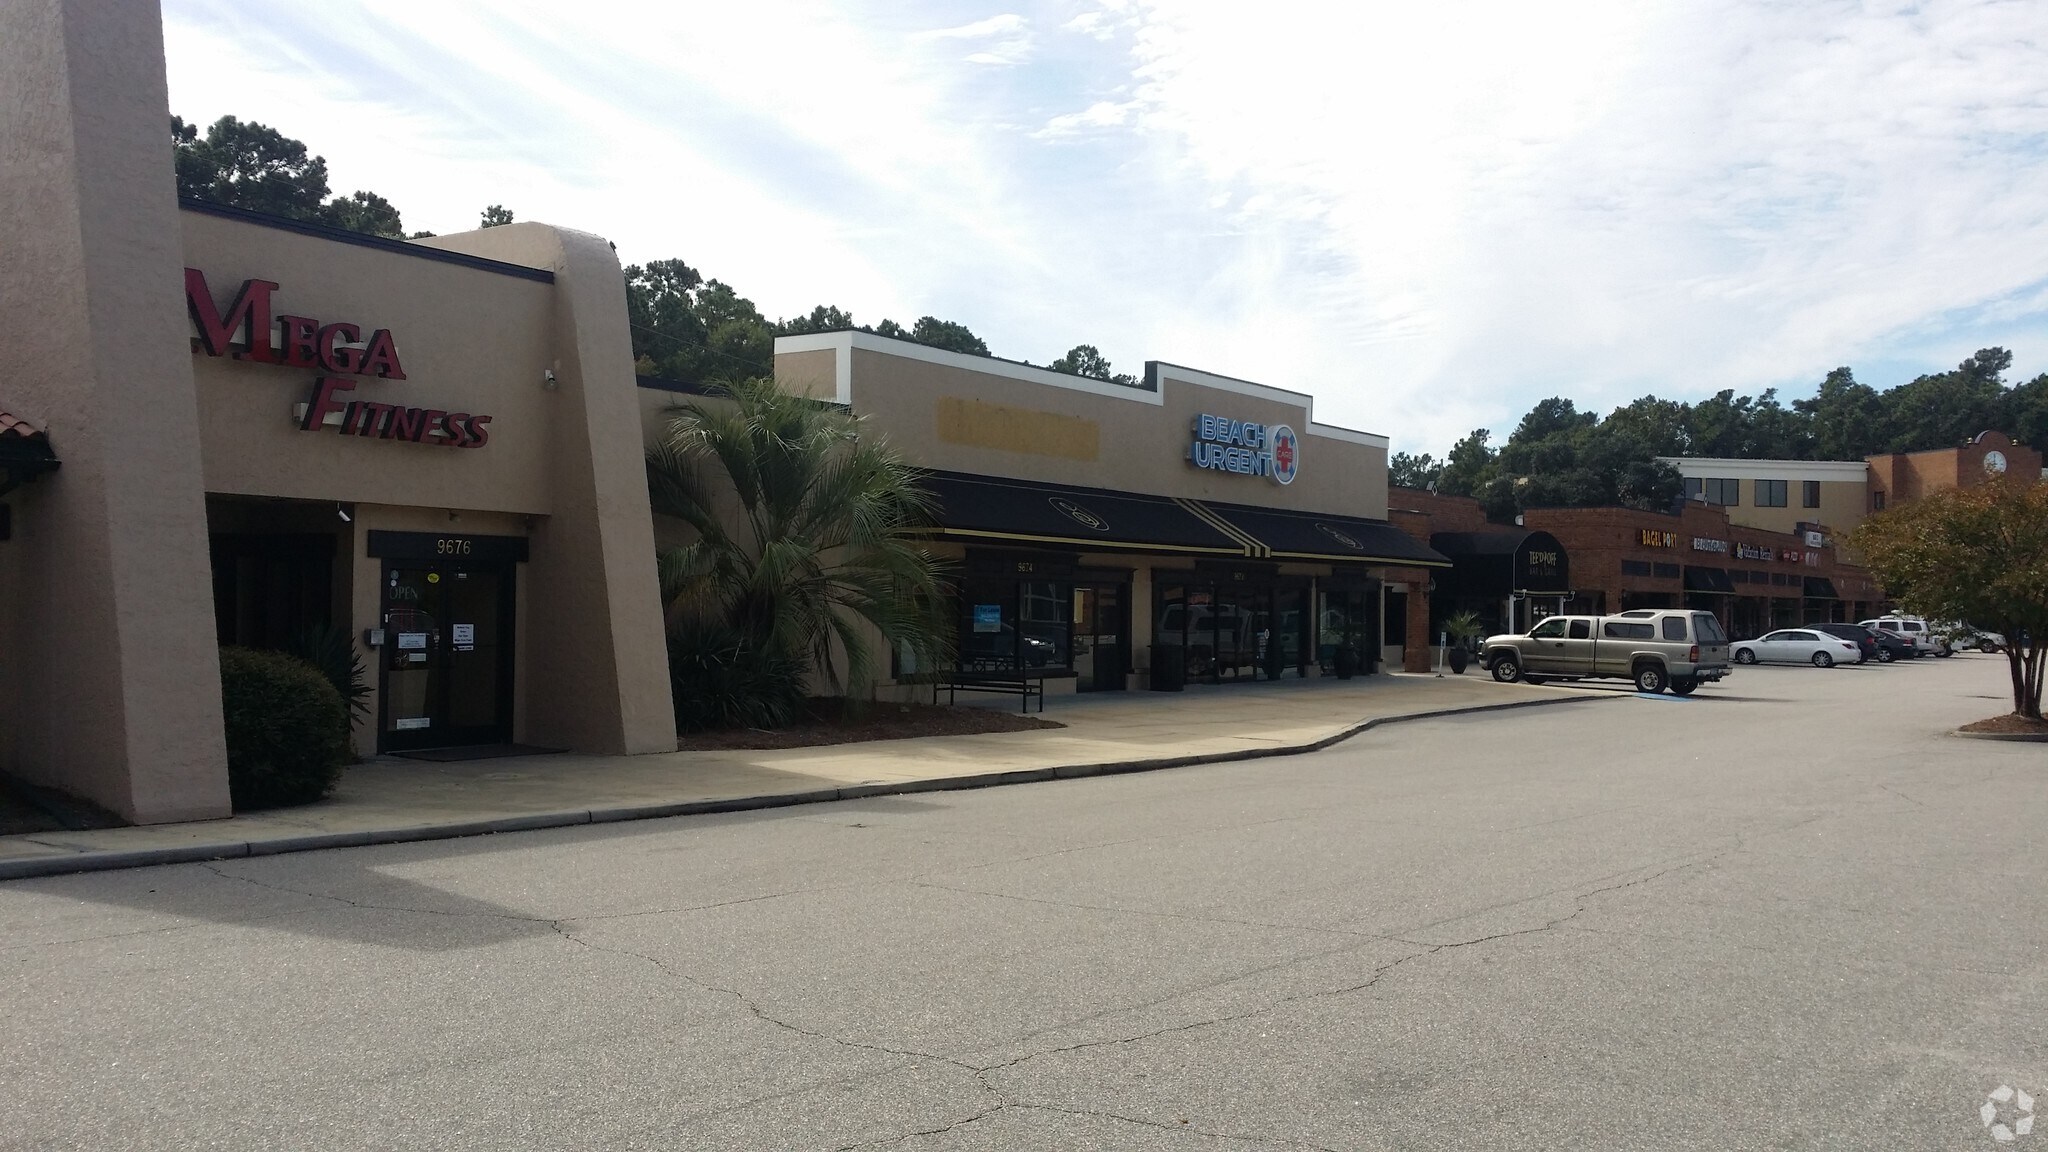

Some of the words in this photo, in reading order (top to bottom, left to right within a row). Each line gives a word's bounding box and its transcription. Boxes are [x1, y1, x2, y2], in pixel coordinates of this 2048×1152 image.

[301, 377, 493, 449] FITNESS
[1199, 413, 1268, 449] BEACH
[1193, 441, 1272, 477] URGENT
[1277, 449, 1293, 460] CARE
[437, 539, 471, 555] 9676
[1642, 529, 1662, 547] BAGEL
[1663, 532, 1678, 548] PORT
[389, 585, 419, 600] OPEN
